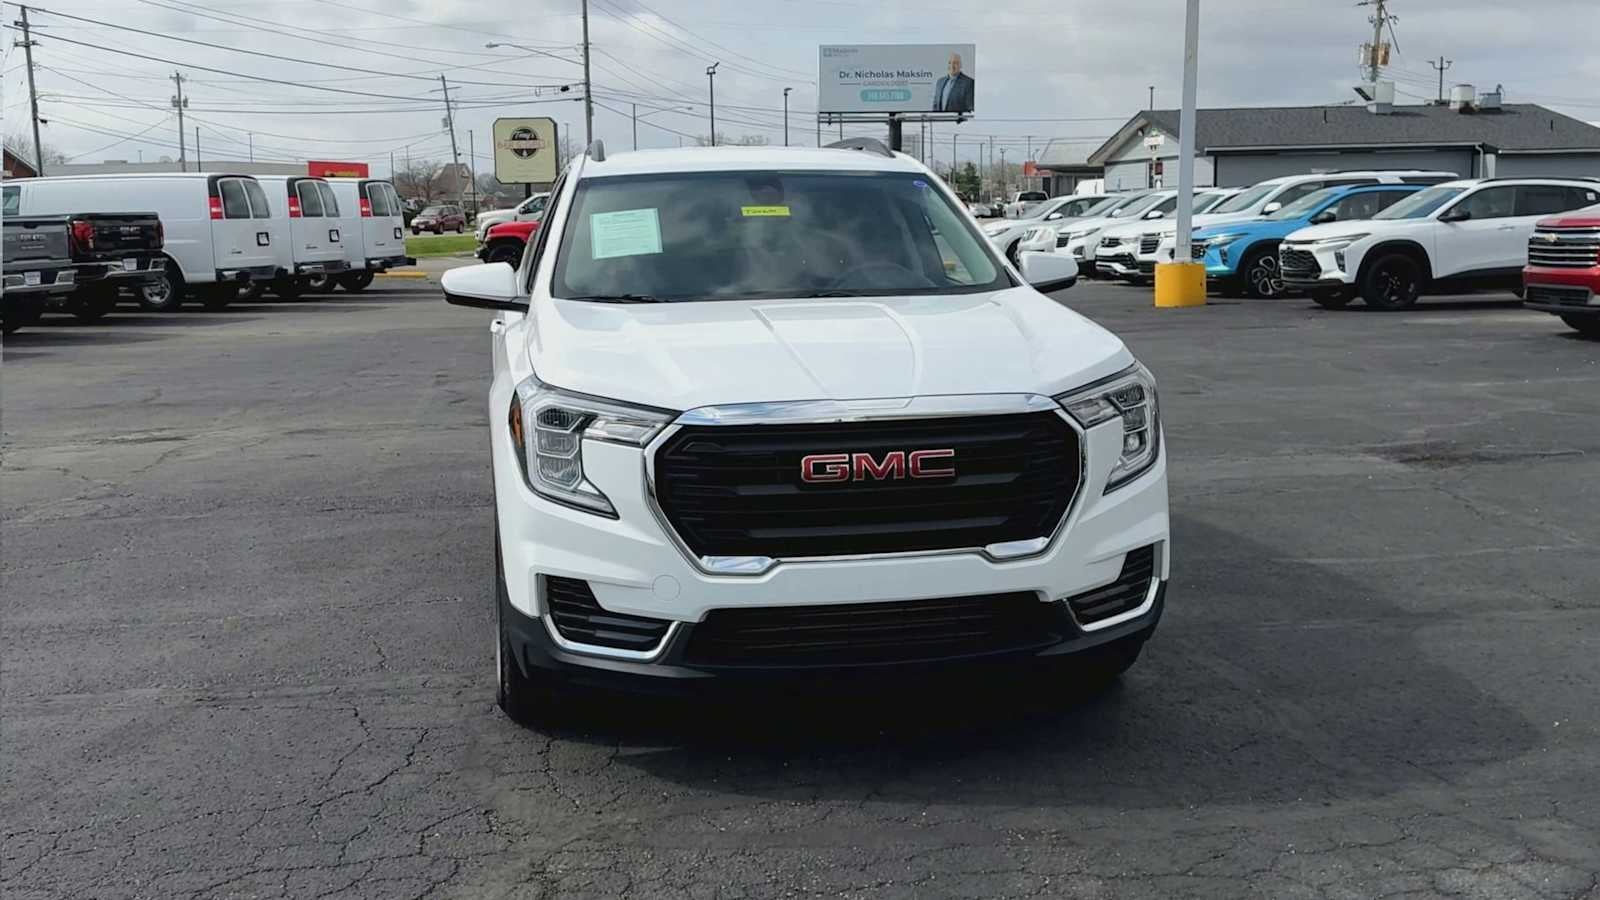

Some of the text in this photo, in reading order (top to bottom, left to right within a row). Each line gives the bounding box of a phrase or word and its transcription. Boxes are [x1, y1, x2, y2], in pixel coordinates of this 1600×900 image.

[839, 70, 933, 79] Dr. Nicholas Maksim
[801, 449, 955, 483] GMC
